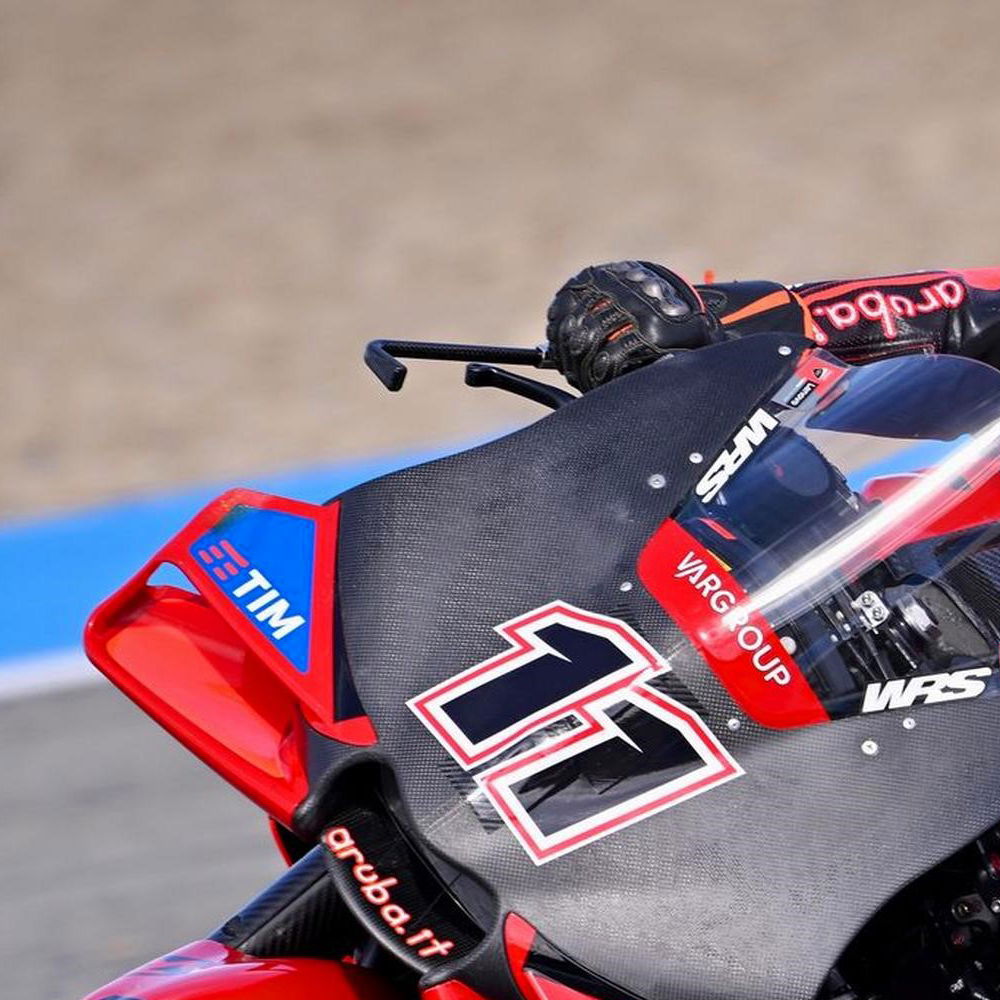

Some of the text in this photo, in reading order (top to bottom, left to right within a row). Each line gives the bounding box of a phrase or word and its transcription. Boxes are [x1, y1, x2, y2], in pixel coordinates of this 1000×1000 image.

[696, 408, 778, 503] WRS
[232, 569, 306, 640] TIM
[405, 600, 746, 866] 11
[861, 667, 992, 714] WRS
[324, 826, 455, 958] aruba.it
